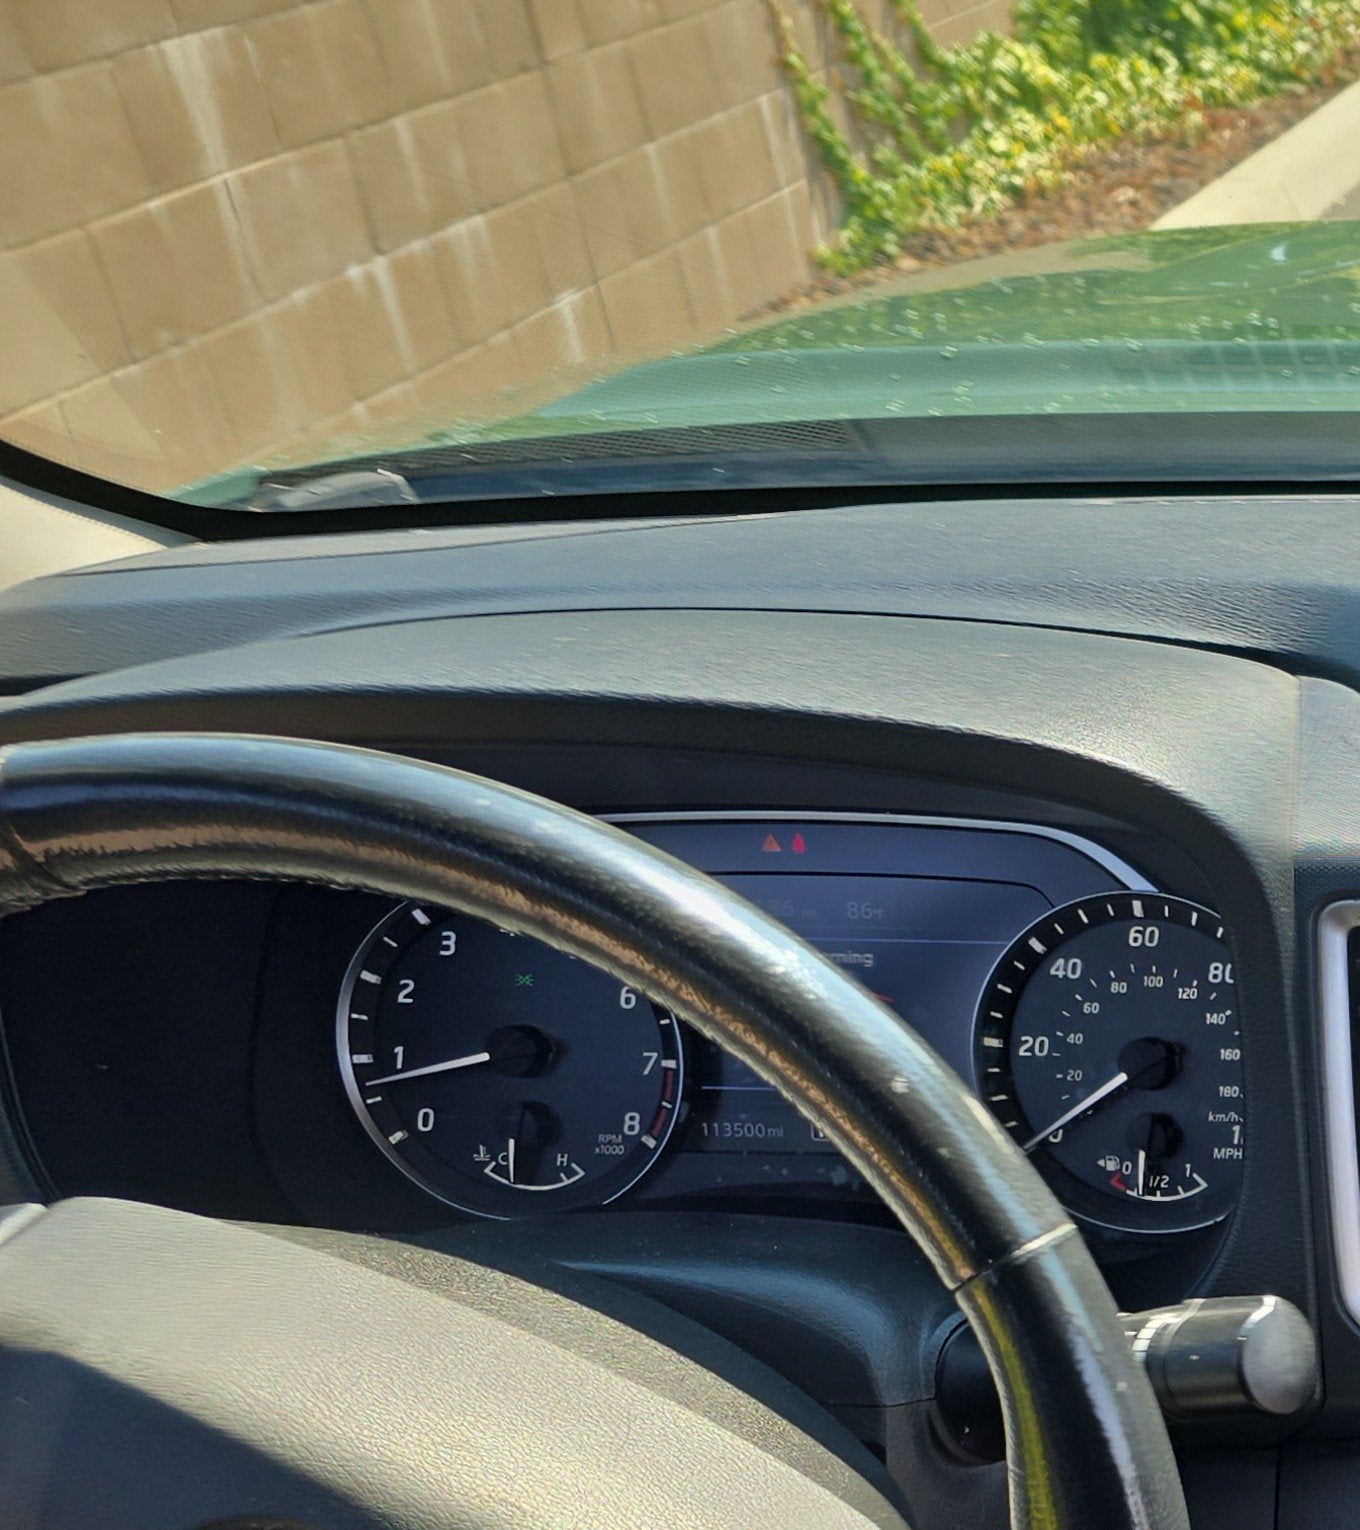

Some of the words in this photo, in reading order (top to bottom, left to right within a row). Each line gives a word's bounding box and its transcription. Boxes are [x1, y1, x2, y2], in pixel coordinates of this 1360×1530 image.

[1128, 926, 1160, 947] 60
[439, 931, 457, 956] 3
[1050, 958, 1083, 980] 40
[1110, 982, 1128, 994] 80
[1143, 976, 1164, 988] 100
[397, 980, 415, 1004] 2
[619, 986, 636, 1010] 6
[1178, 988, 1198, 1000] 120
[1083, 1002, 1100, 1014] 60
[1205, 1013, 1227, 1026] 140
[1066, 1033, 1084, 1045] 40
[1018, 1035, 1049, 1057] 20
[394, 1045, 404, 1069] 1
[1220, 1049, 1242, 1061] 160
[643, 1053, 658, 1076] 7
[1066, 1070, 1083, 1082] 20
[1218, 1086, 1240, 1098] 180
[417, 1108, 434, 1131] 0
[624, 1112, 641, 1135] 8
[1208, 1111, 1239, 1123] km/h
[598, 1134, 623, 1143] RPM
[595, 1145, 625, 1155] x1000
[1213, 1147, 1243, 1160] MPH
[498, 1152, 508, 1165] C
[556, 1153, 568, 1167] H
[1122, 1161, 1132, 1175] 0
[1184, 1163, 1192, 1178] 1
[1150, 1175, 1170, 1188] 1/2
